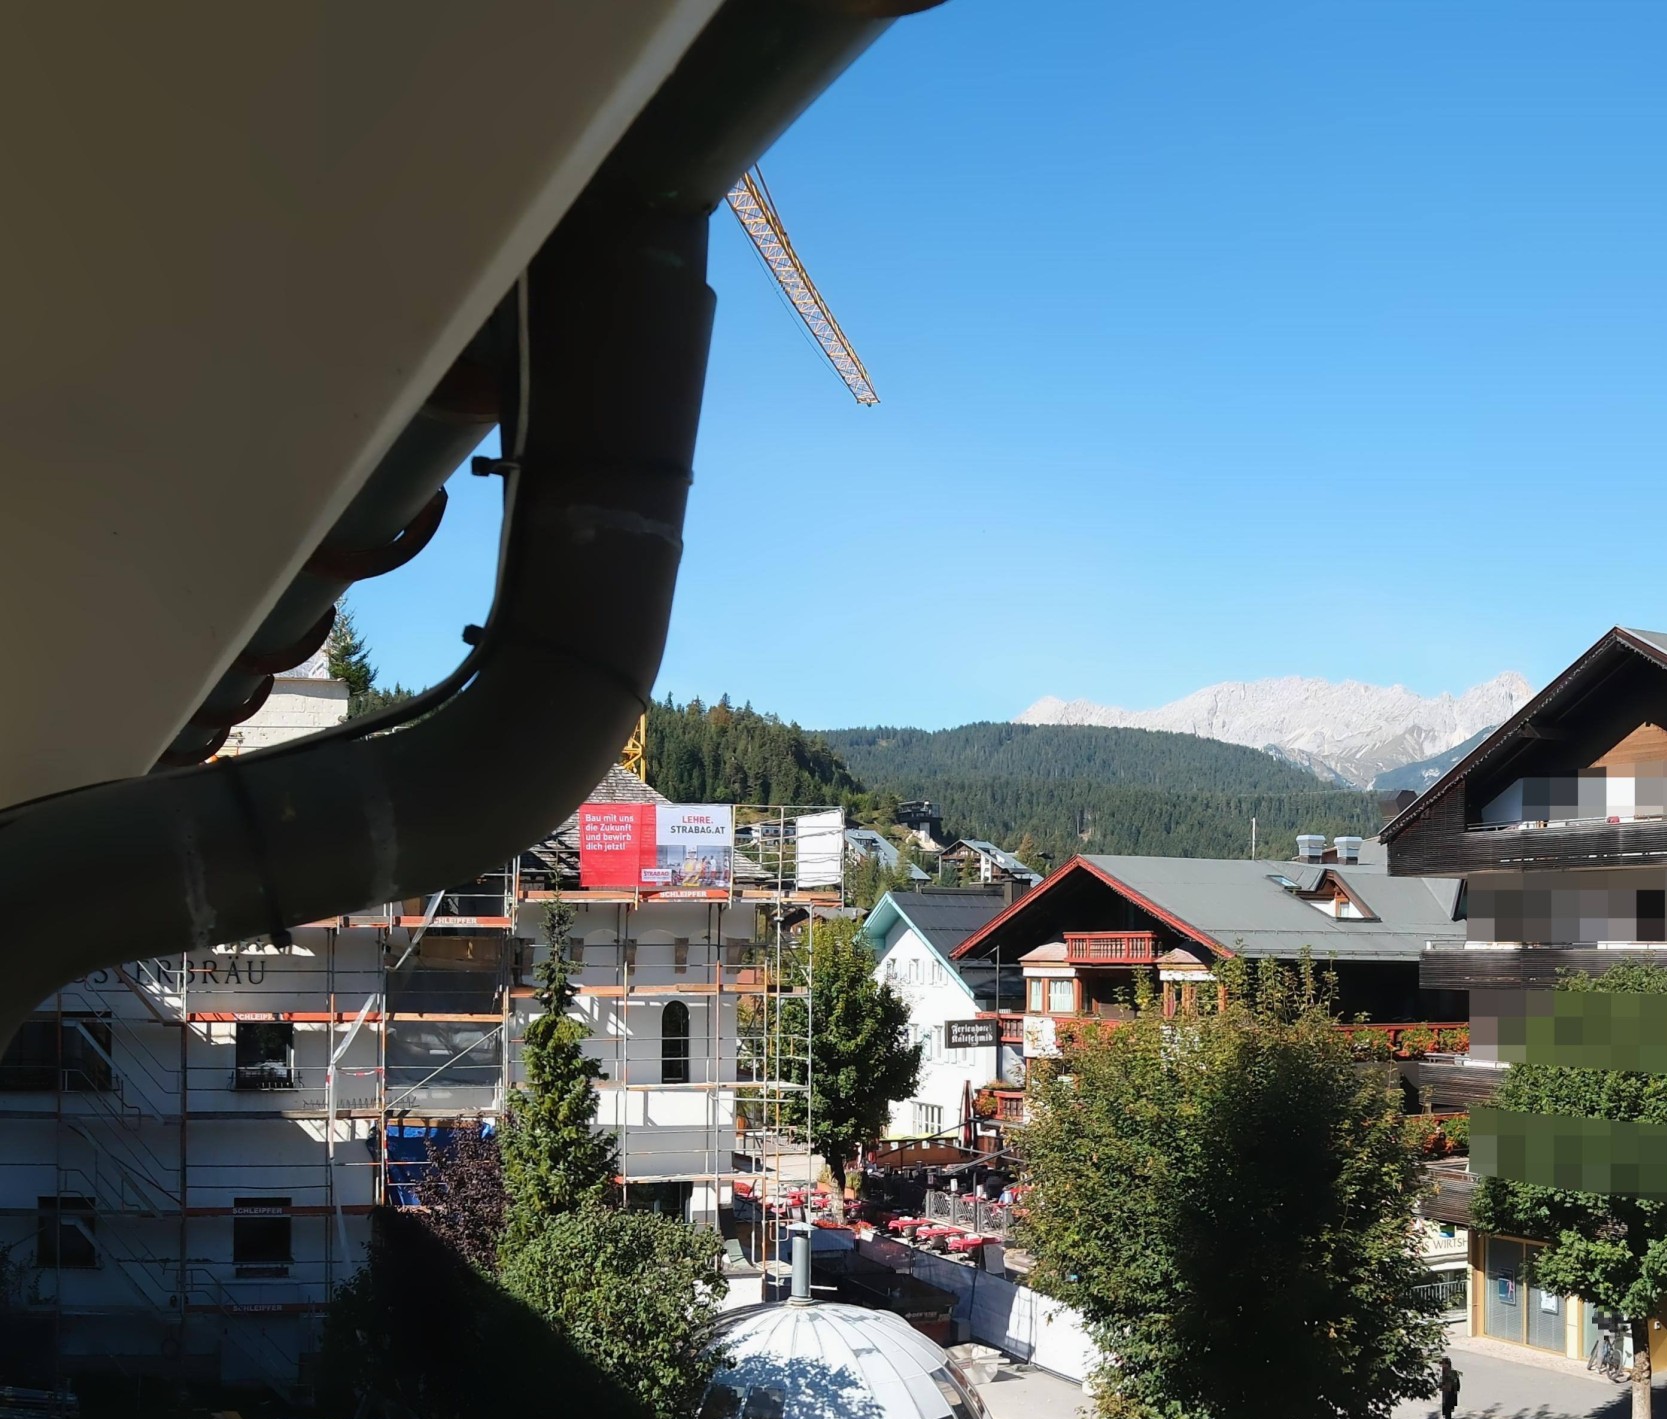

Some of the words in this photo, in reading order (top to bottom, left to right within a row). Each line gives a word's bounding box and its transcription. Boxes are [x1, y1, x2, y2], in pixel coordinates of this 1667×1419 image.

[585, 814, 601, 822] Bau
[603, 813, 617, 822] mit
[682, 815, 714, 824] LEHRE.
[600, 824, 632, 832] Zukunft
[670, 825, 726, 834] STRABAG.AT
[585, 833, 601, 841] und
[603, 833, 632, 841] bewirb
[585, 842, 603, 850] dich
[604, 842, 626, 852] jetzt!
[433, 916, 477, 924] CHLEIPFER
